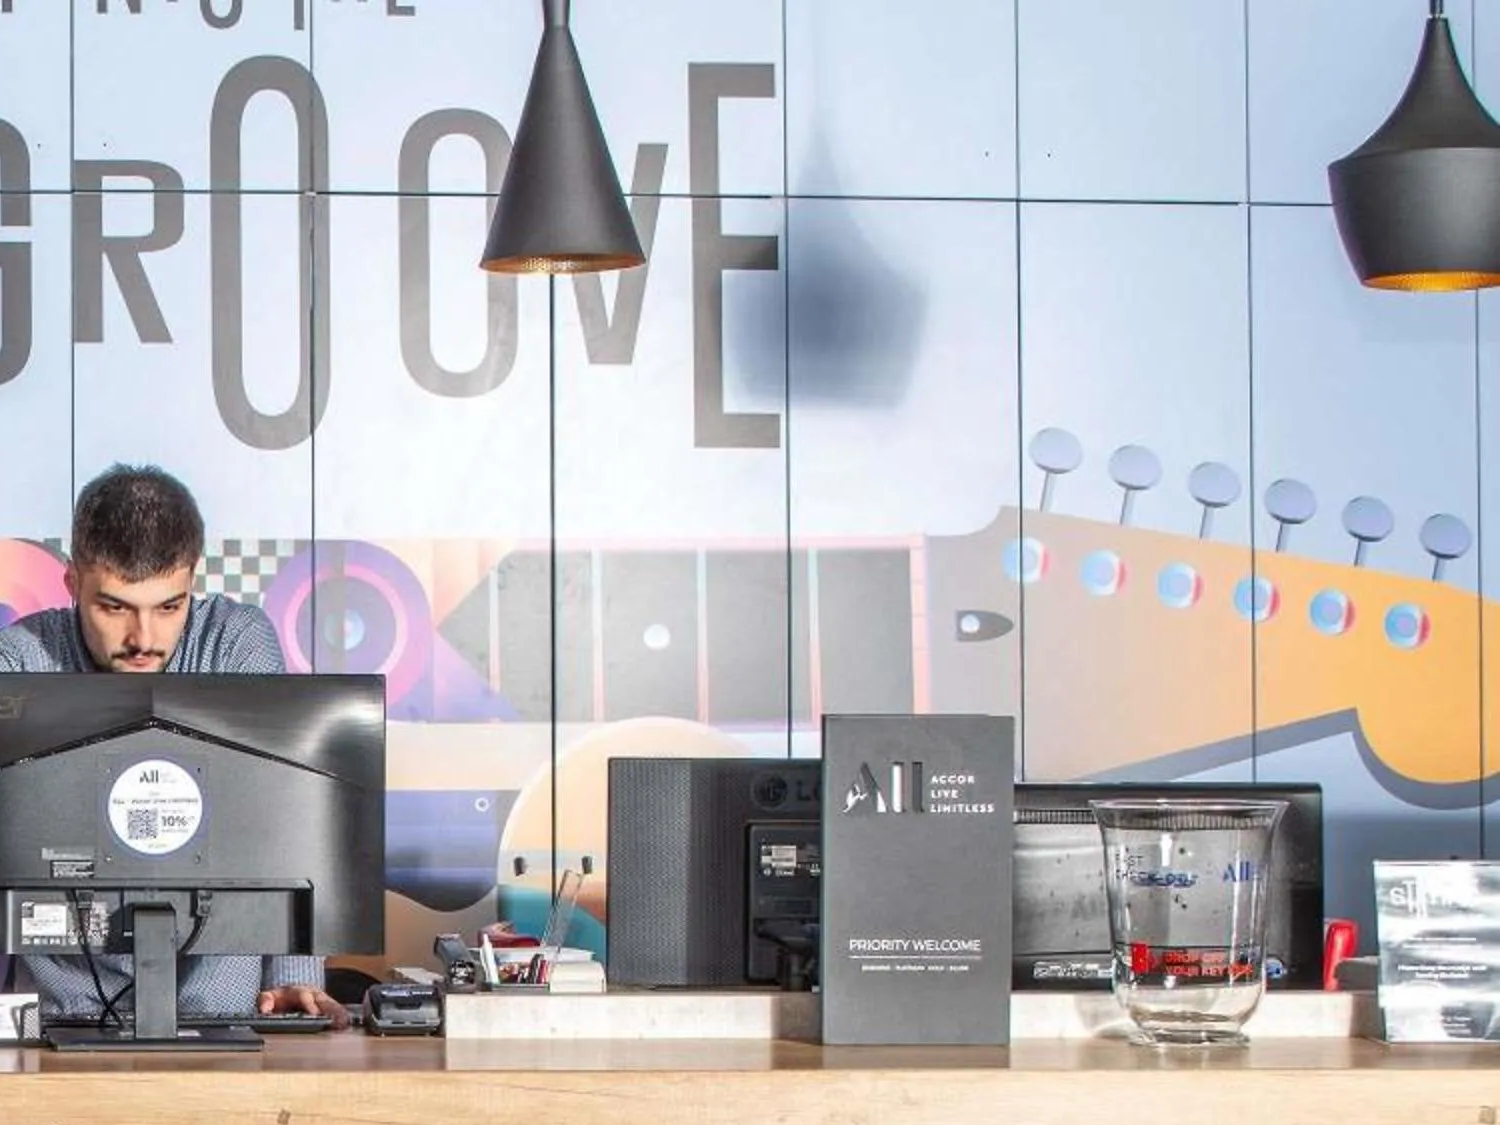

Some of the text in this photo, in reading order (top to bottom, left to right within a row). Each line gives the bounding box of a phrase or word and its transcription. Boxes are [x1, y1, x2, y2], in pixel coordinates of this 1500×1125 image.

[930, 774, 975, 784] ACCOR
[842, 761, 925, 814] All
[930, 789, 959, 799] LIVE
[930, 803, 995, 813] LIMITLESS
[161, 815, 188, 827] 10%
[849, 939, 981, 951] PRIORITY WELCOME
